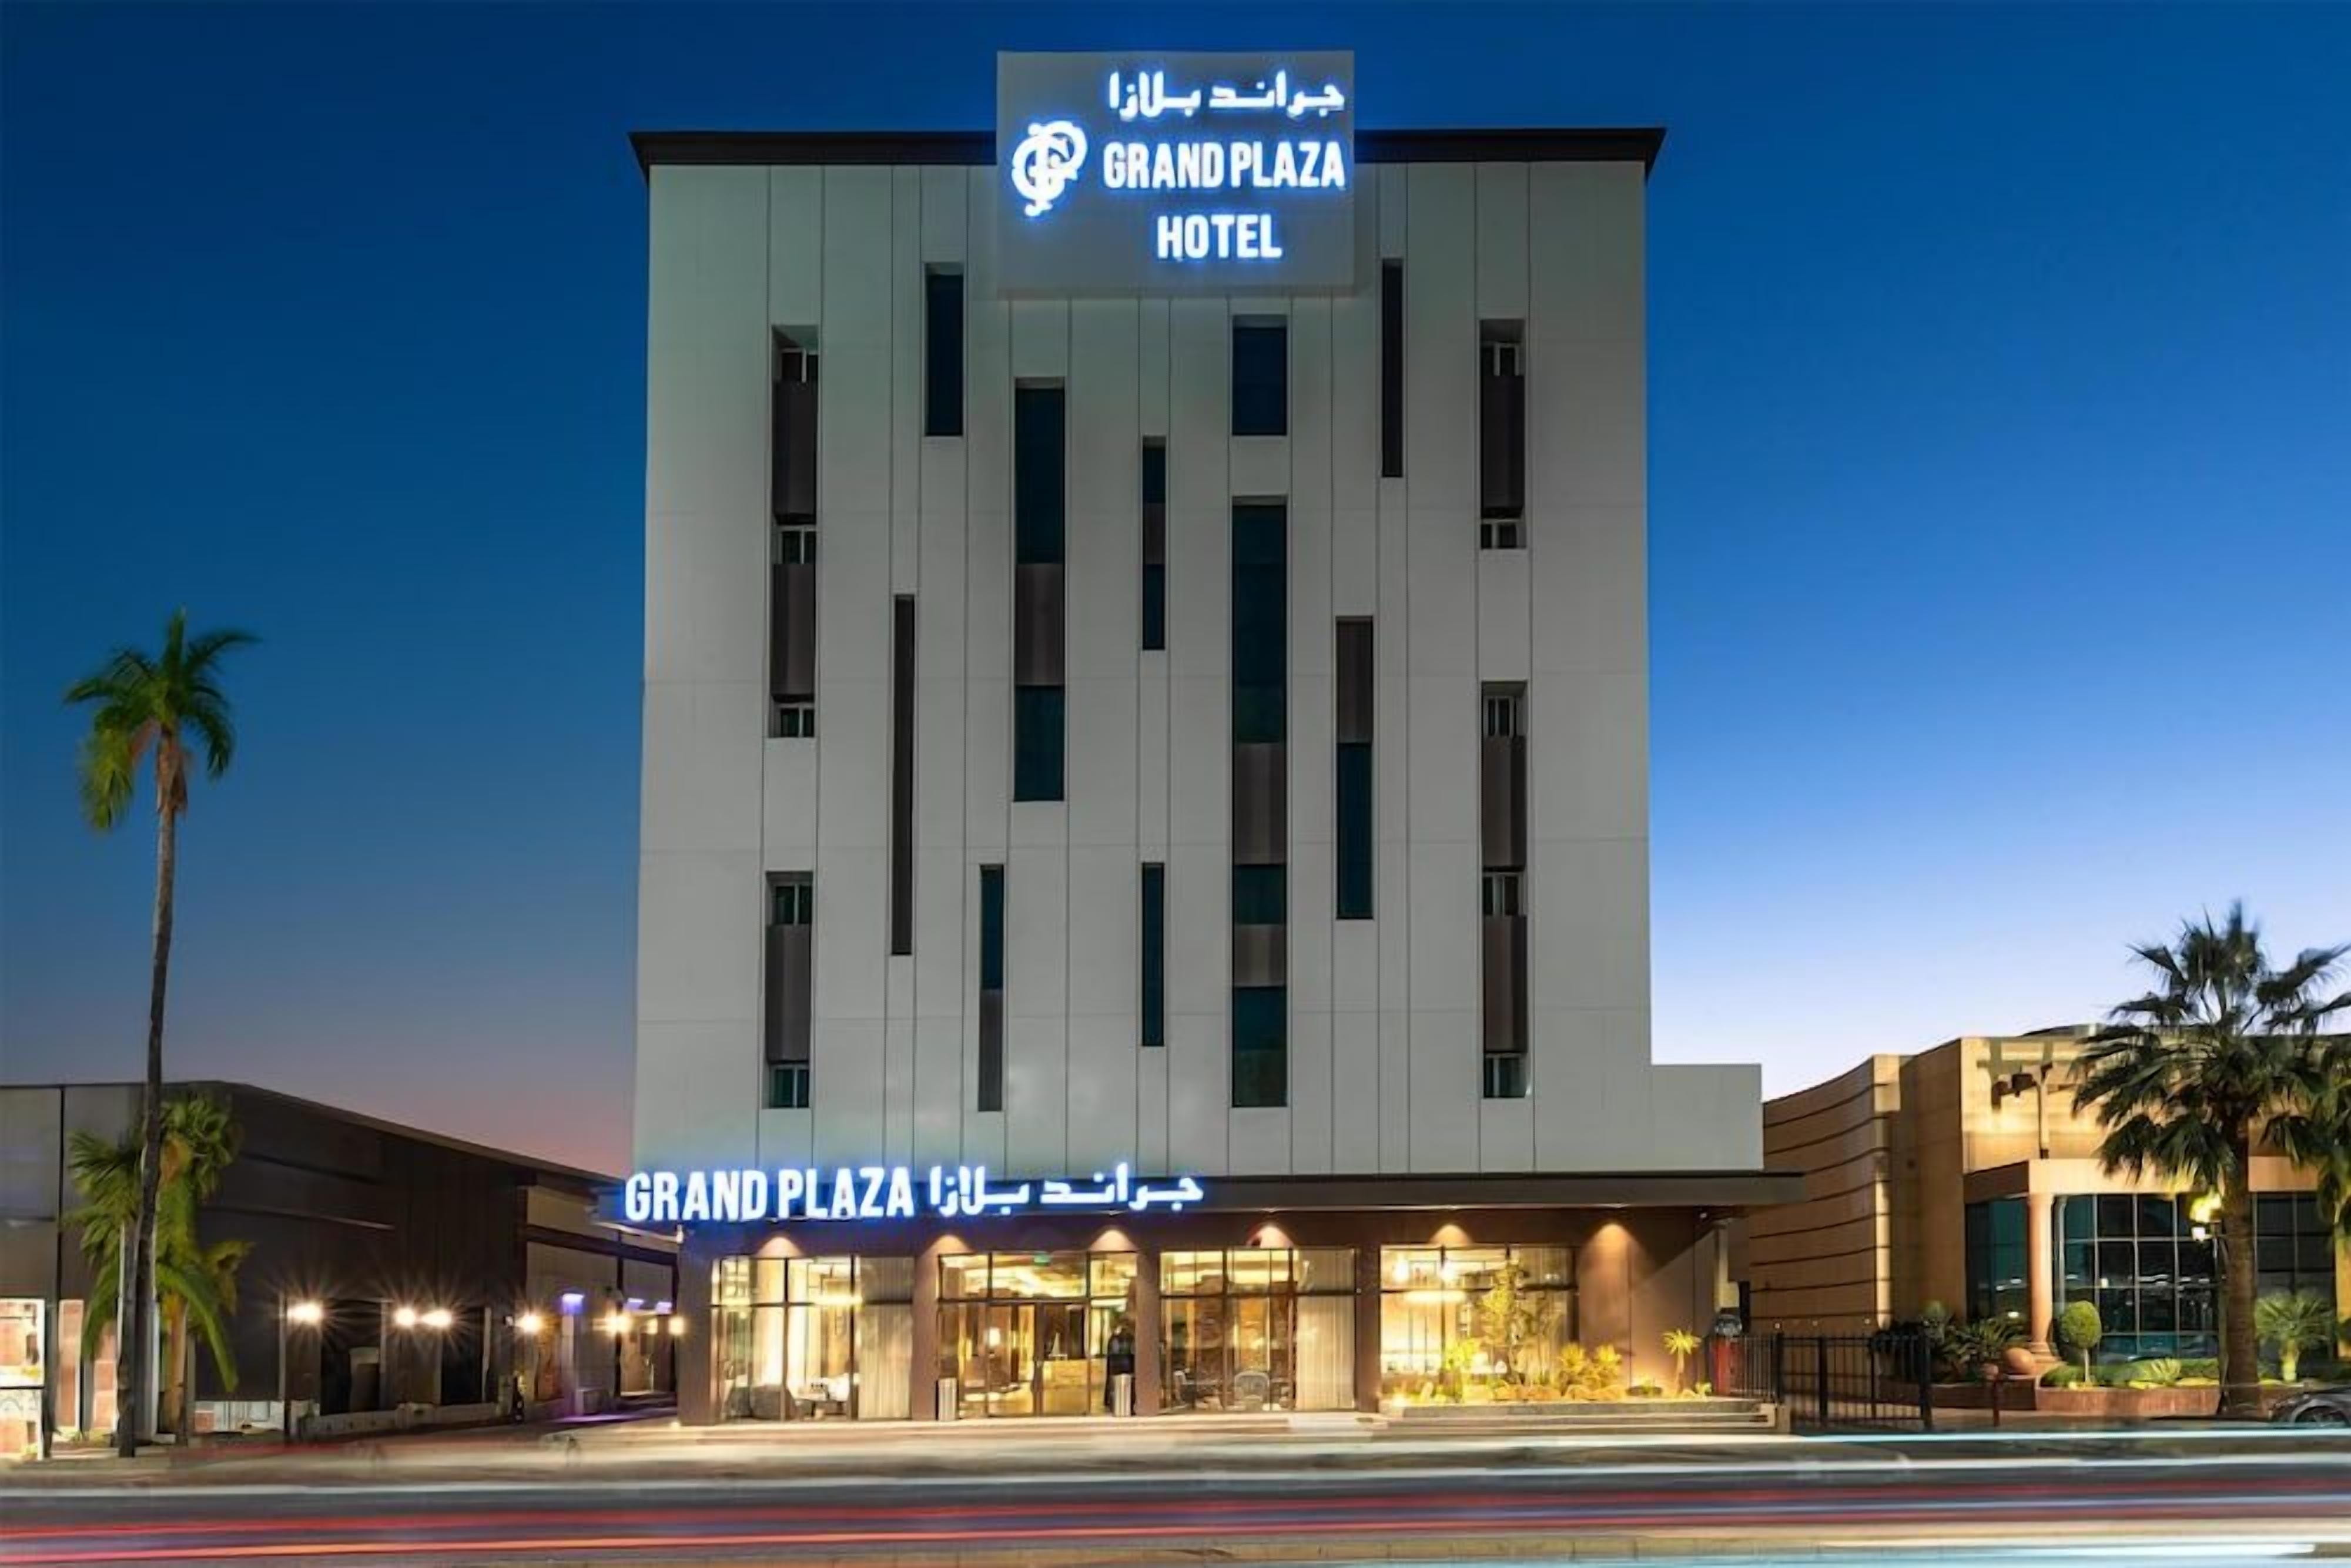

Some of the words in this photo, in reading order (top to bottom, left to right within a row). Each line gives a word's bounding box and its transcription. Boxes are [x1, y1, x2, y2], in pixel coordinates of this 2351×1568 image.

[1109, 71, 1201, 119] بلازا
[1209, 71, 1345, 116] جراند
[1104, 142, 1224, 188] GRAND
[1230, 142, 1345, 187] PLAZA
[1158, 215, 1282, 258] HOTEL
[625, 1170, 767, 1221] GRAND
[778, 1166, 915, 1219] PLAZA
[929, 1165, 1029, 1217] بلازا
[1040, 1162, 1203, 1211] جراند
